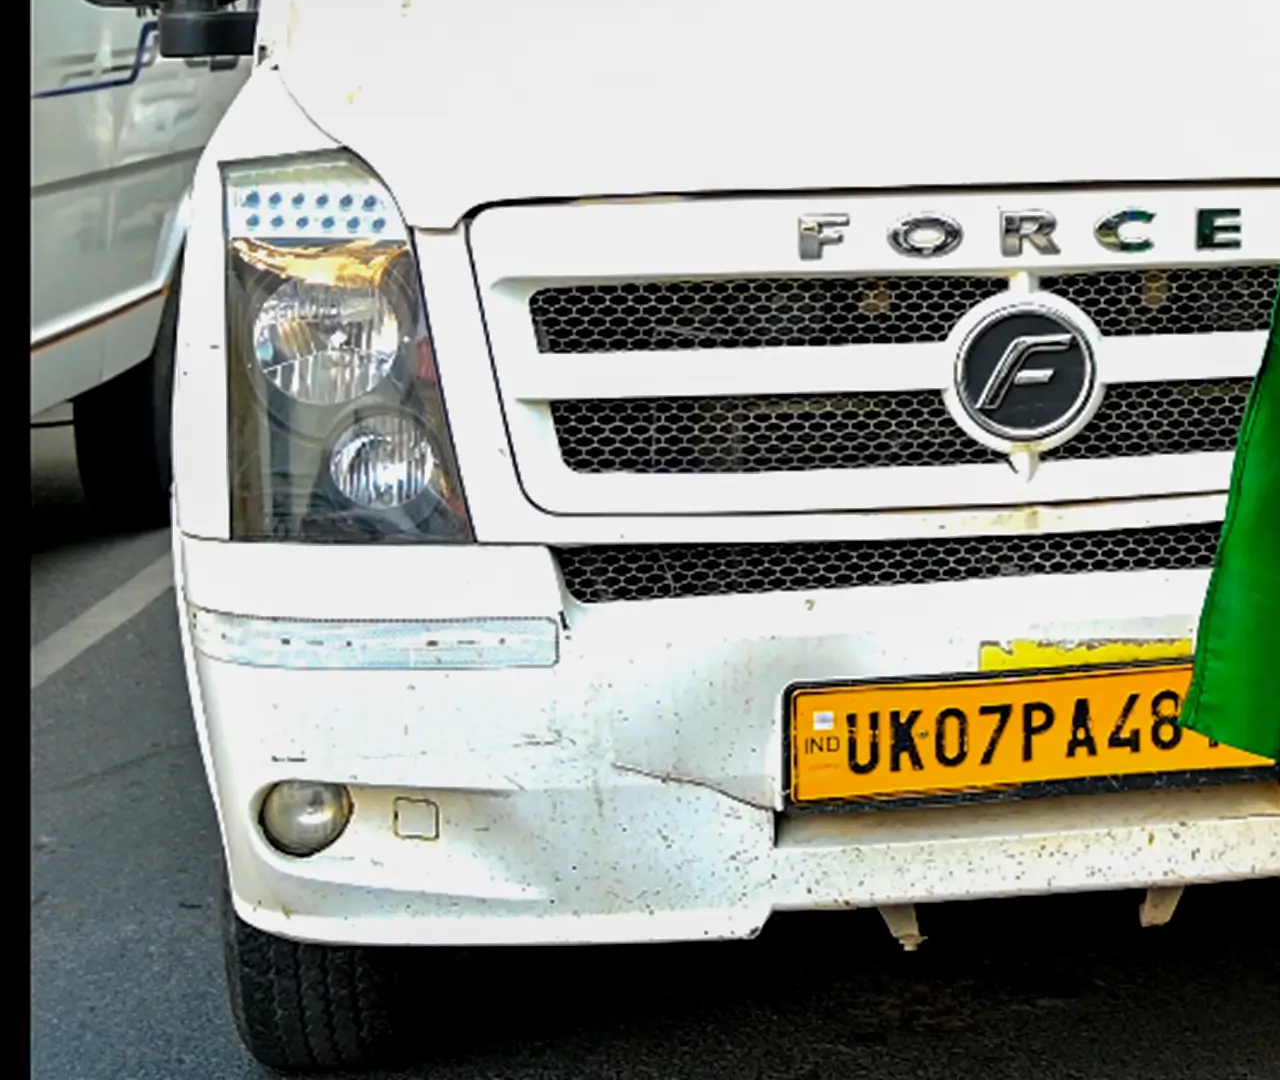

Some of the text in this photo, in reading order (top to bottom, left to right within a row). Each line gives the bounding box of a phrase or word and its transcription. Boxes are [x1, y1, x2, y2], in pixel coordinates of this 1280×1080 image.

[797, 206, 1242, 261] FORCE
[804, 688, 1219, 776] IND UK07PA48
